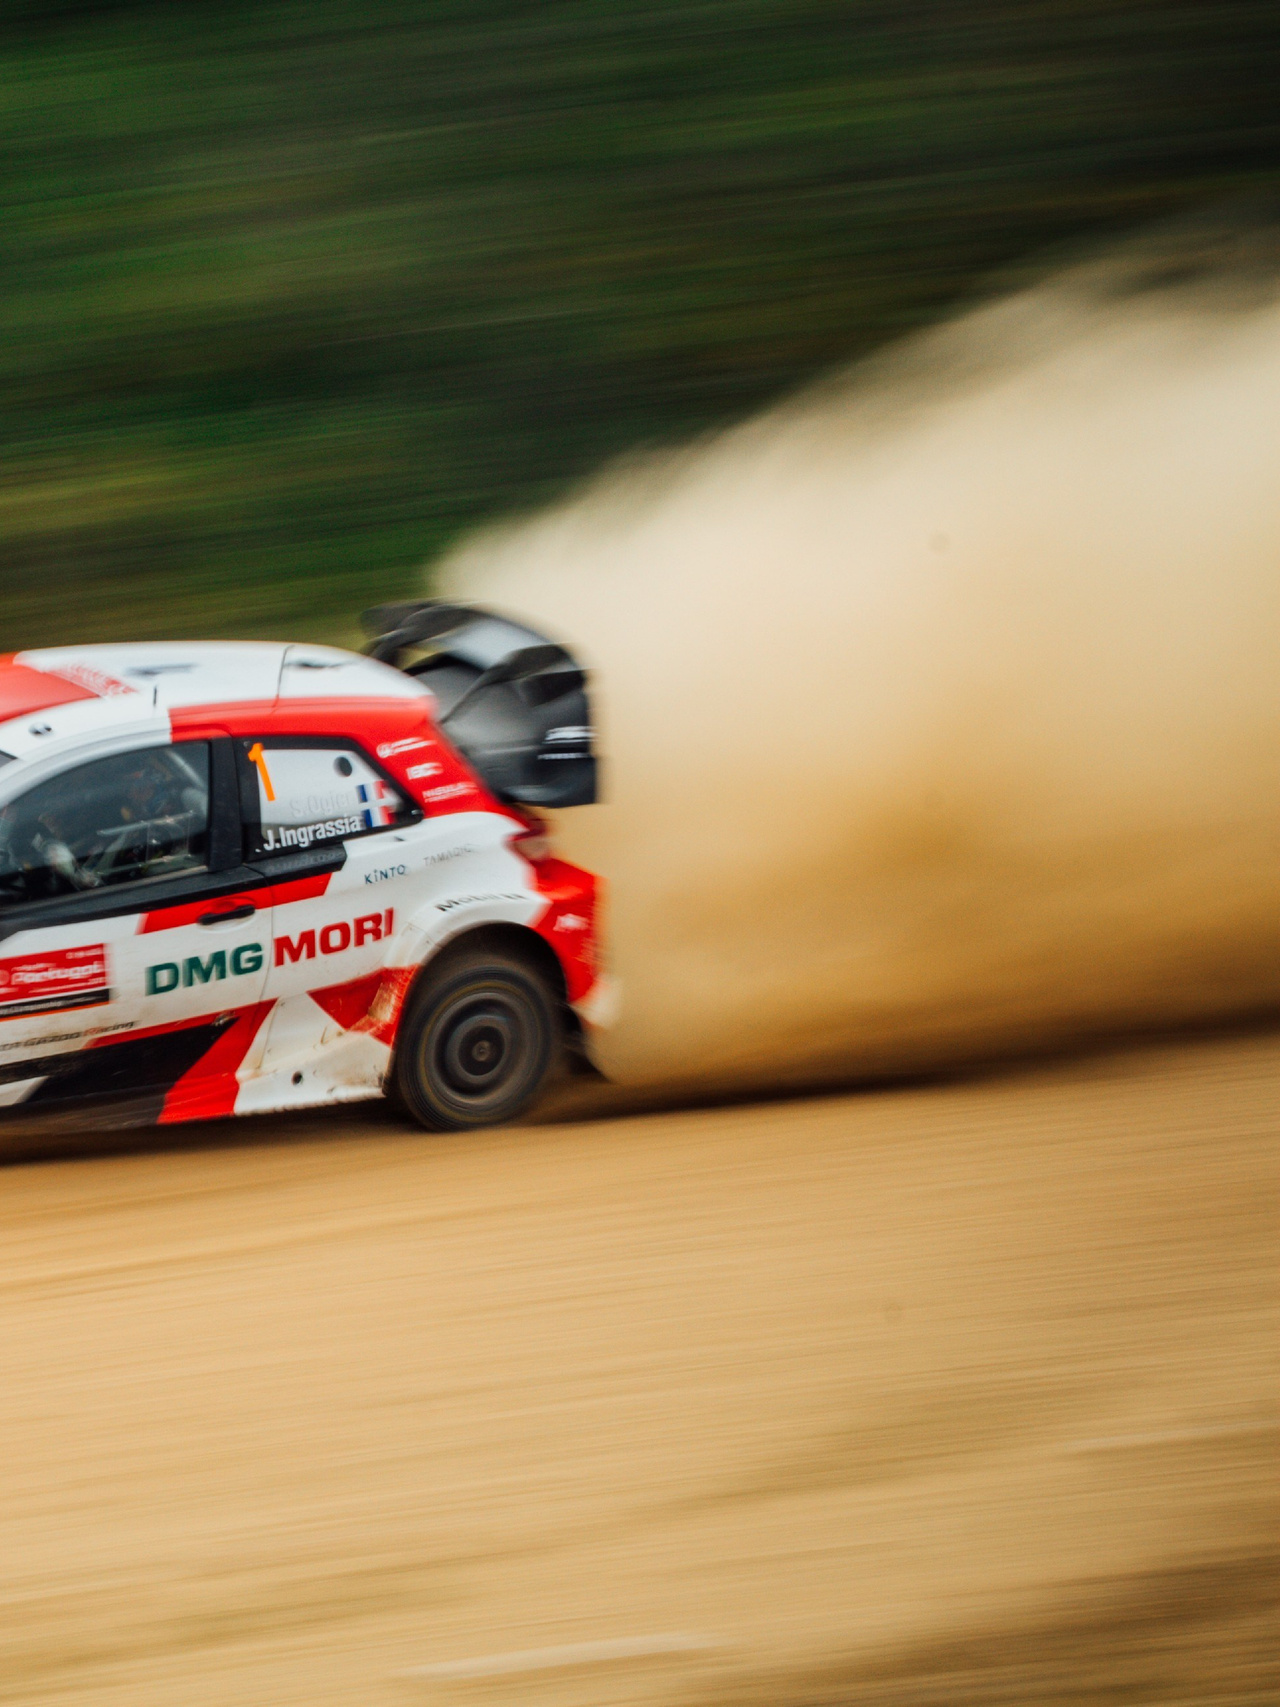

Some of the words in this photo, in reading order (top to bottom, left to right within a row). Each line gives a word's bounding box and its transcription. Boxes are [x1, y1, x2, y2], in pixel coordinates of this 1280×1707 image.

[248, 742, 276, 802] 1
[263, 814, 362, 851] J.Ingrassia
[144, 942, 264, 997] DMG
[273, 906, 395, 968] MORI
